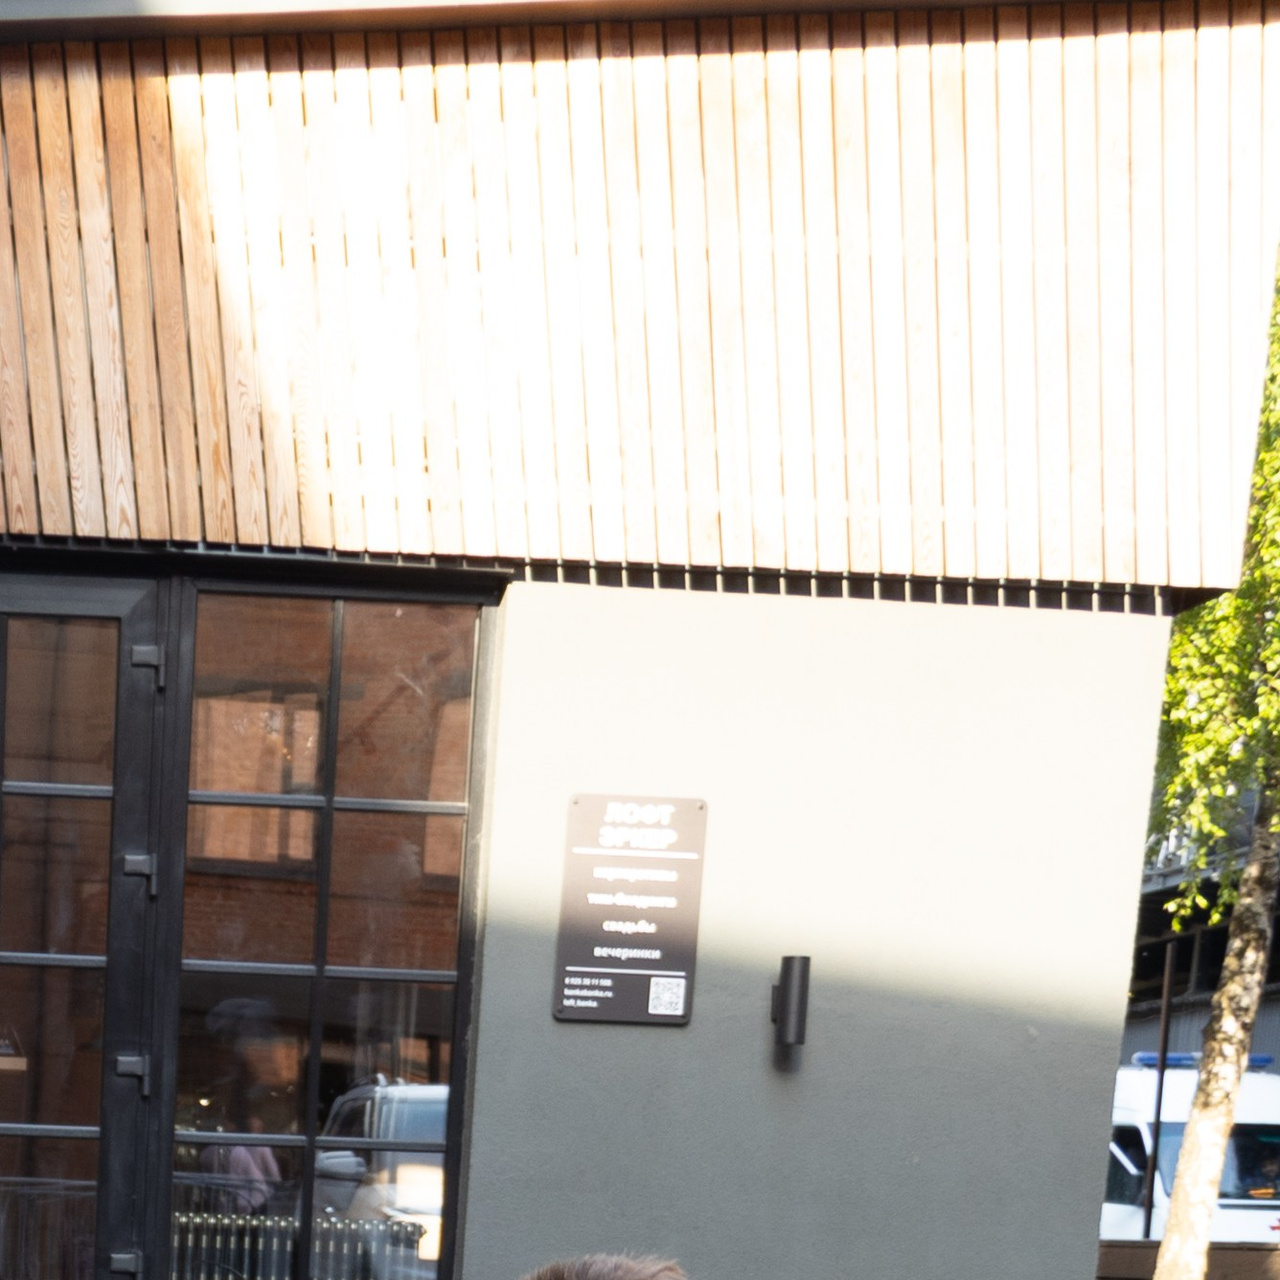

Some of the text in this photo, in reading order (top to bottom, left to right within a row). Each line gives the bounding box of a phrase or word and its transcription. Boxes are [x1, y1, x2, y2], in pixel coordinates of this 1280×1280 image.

[604, 802, 675, 825] ЛОФТ
[602, 920, 656, 934] свадьбы
[594, 947, 661, 960] вечеринки
